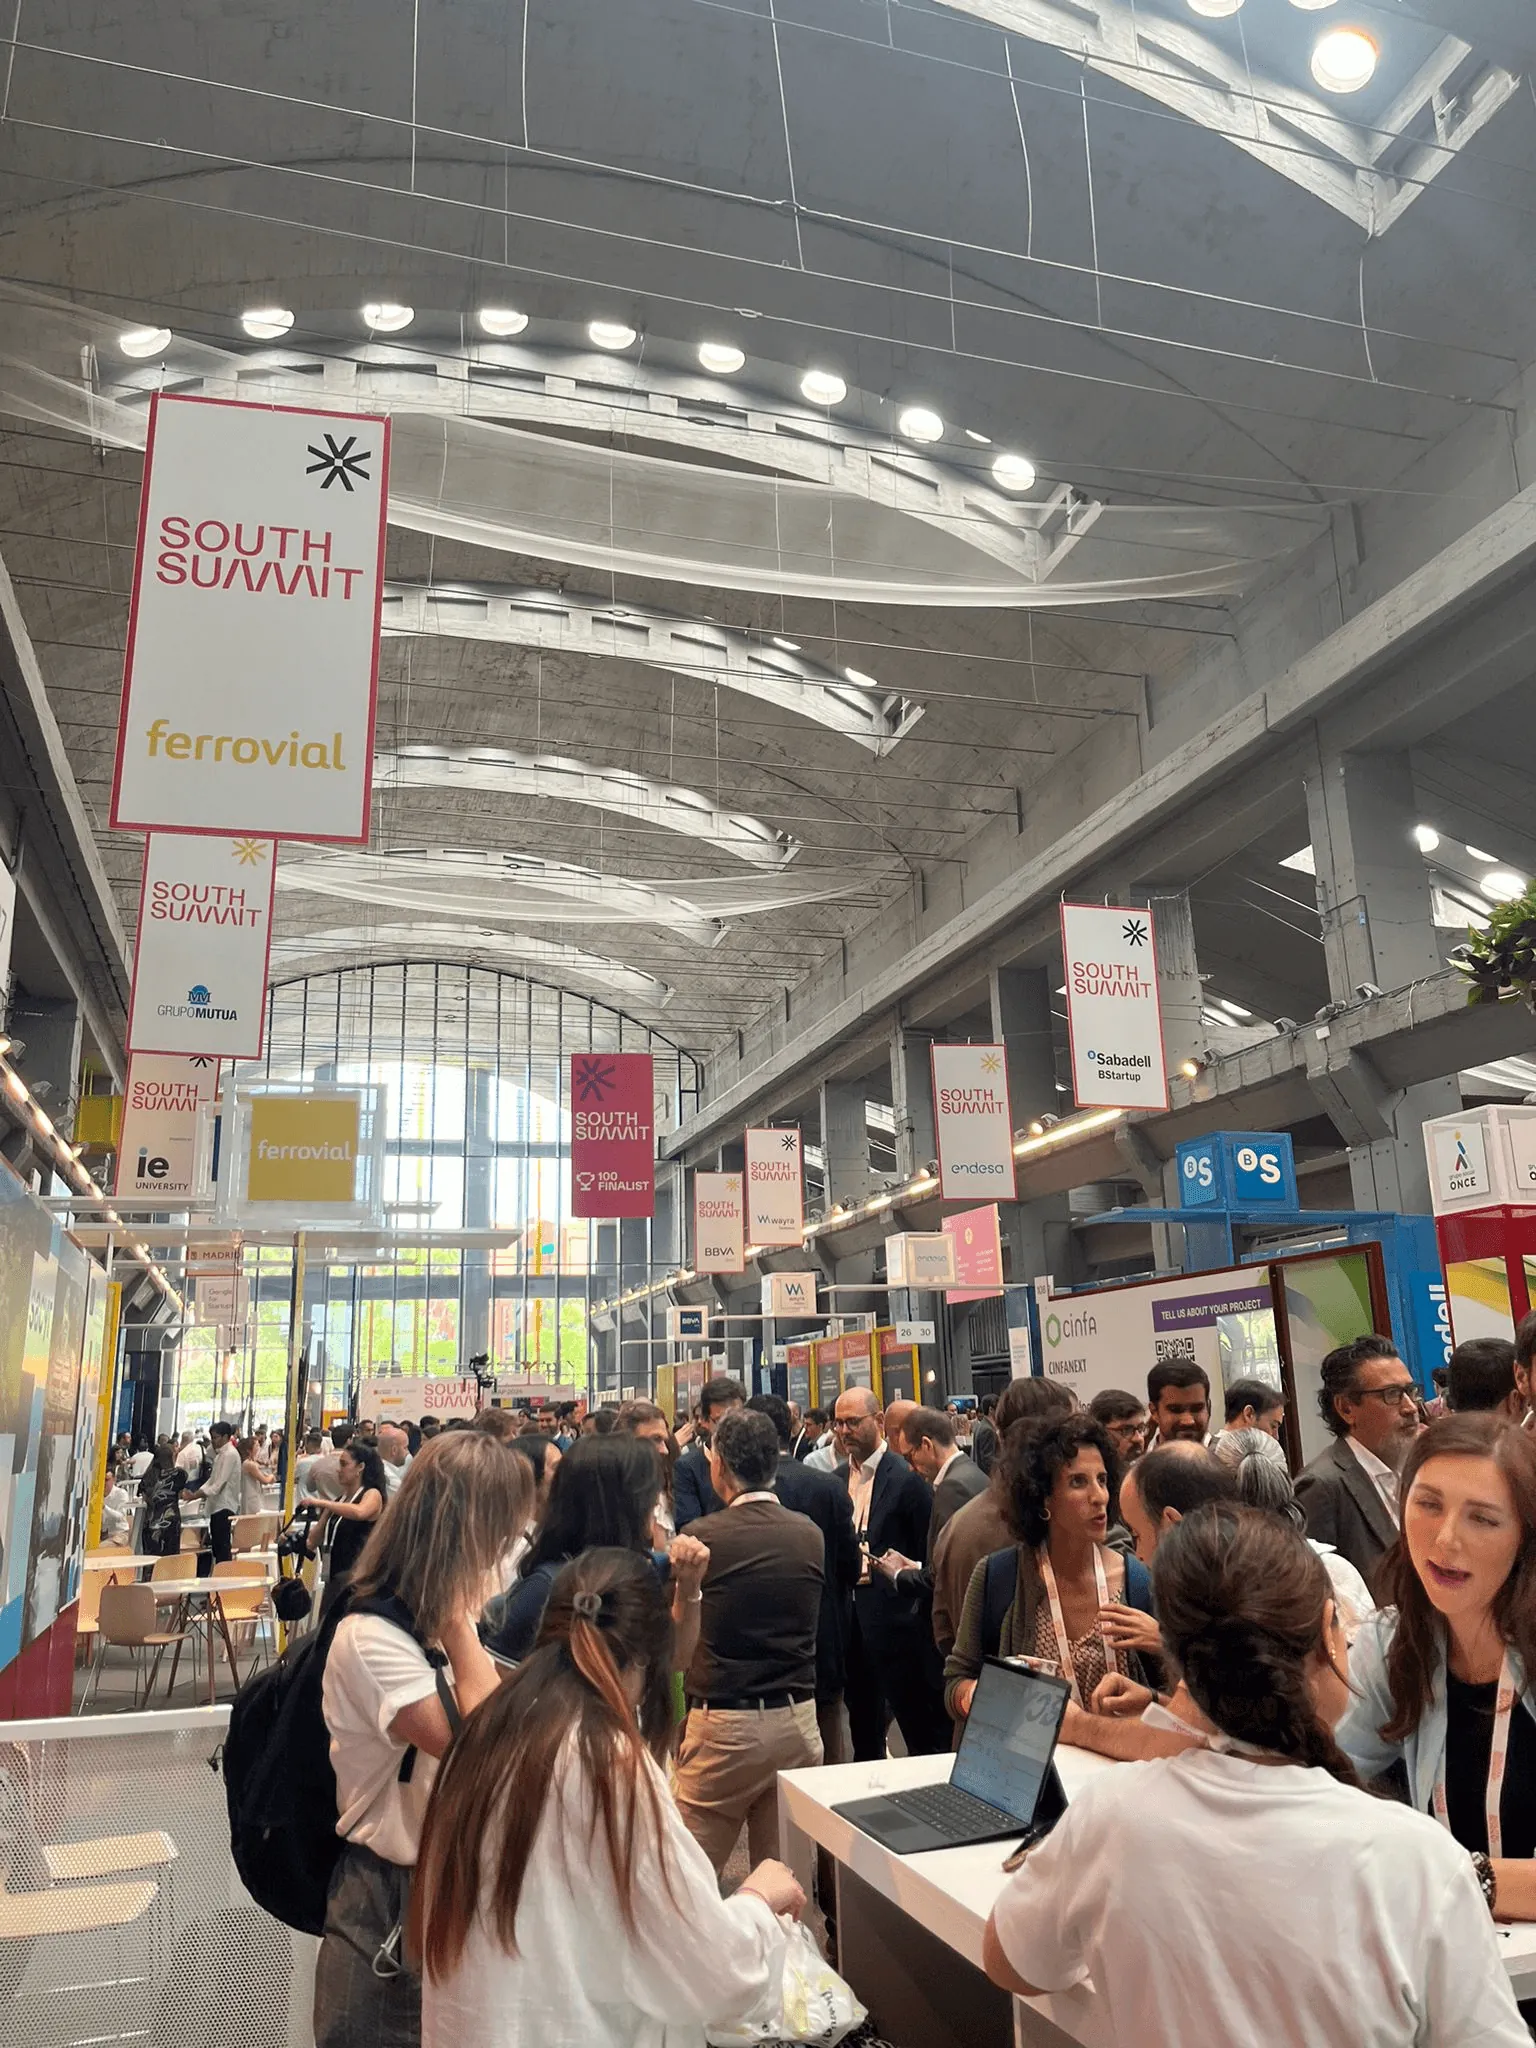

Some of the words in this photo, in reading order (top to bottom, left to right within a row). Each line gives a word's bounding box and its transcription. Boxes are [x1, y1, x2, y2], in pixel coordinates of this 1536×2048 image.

[159, 516, 332, 563] SOUTH
[156, 551, 364, 600] SUMMIT
[146, 719, 346, 771] ferrovial
[152, 881, 246, 907] SOUTH
[150, 902, 262, 928] SUMMIT
[1073, 962, 1139, 981] SOUTH
[1074, 979, 1151, 998] SUMMIT
[157, 1004, 238, 1021] GRUPOMUTUA
[1097, 1053, 1151, 1068] Sabadell
[1098, 1070, 1141, 1082] BStartup
[134, 1082, 198, 1098] SOUTH
[940, 1088, 994, 1102] SOUTH
[941, 1101, 1004, 1114] SUMMIT
[576, 1112, 638, 1126] SOUTH
[576, 1126, 650, 1140] SUMMIT
[256, 1139, 352, 1161] ferrovial
[137, 1147, 169, 1178] ie
[750, 1161, 790, 1172] SOUTH
[951, 1162, 1004, 1175] endesa
[598, 1172, 618, 1181] 100
[751, 1171, 797, 1181] SUMMIT
[136, 1181, 188, 1191] UNIVERSITY
[598, 1181, 650, 1191] FINALIST
[1450, 1177, 1476, 1190] ONCE
[698, 1200, 734, 1210] SOUTH
[698, 1209, 740, 1218] SUMMIT
[771, 1217, 795, 1226] wayra
[202, 1251, 240, 1260] MADRID
[705, 1247, 734, 1257] BBVA
[1161, 1310, 1176, 1320] TELL
[1177, 1308, 1185, 1319] US
[1186, 1305, 1208, 1317] ABOUT
[1209, 1302, 1228, 1315] YOUR
[1229, 1298, 1261, 1312] PROJECT
[901, 1328, 911, 1336] 26
[920, 1328, 931, 1336] 30
[1048, 1359, 1087, 1375] CINFANEXT
[424, 1382, 477, 1395] SOUTH
